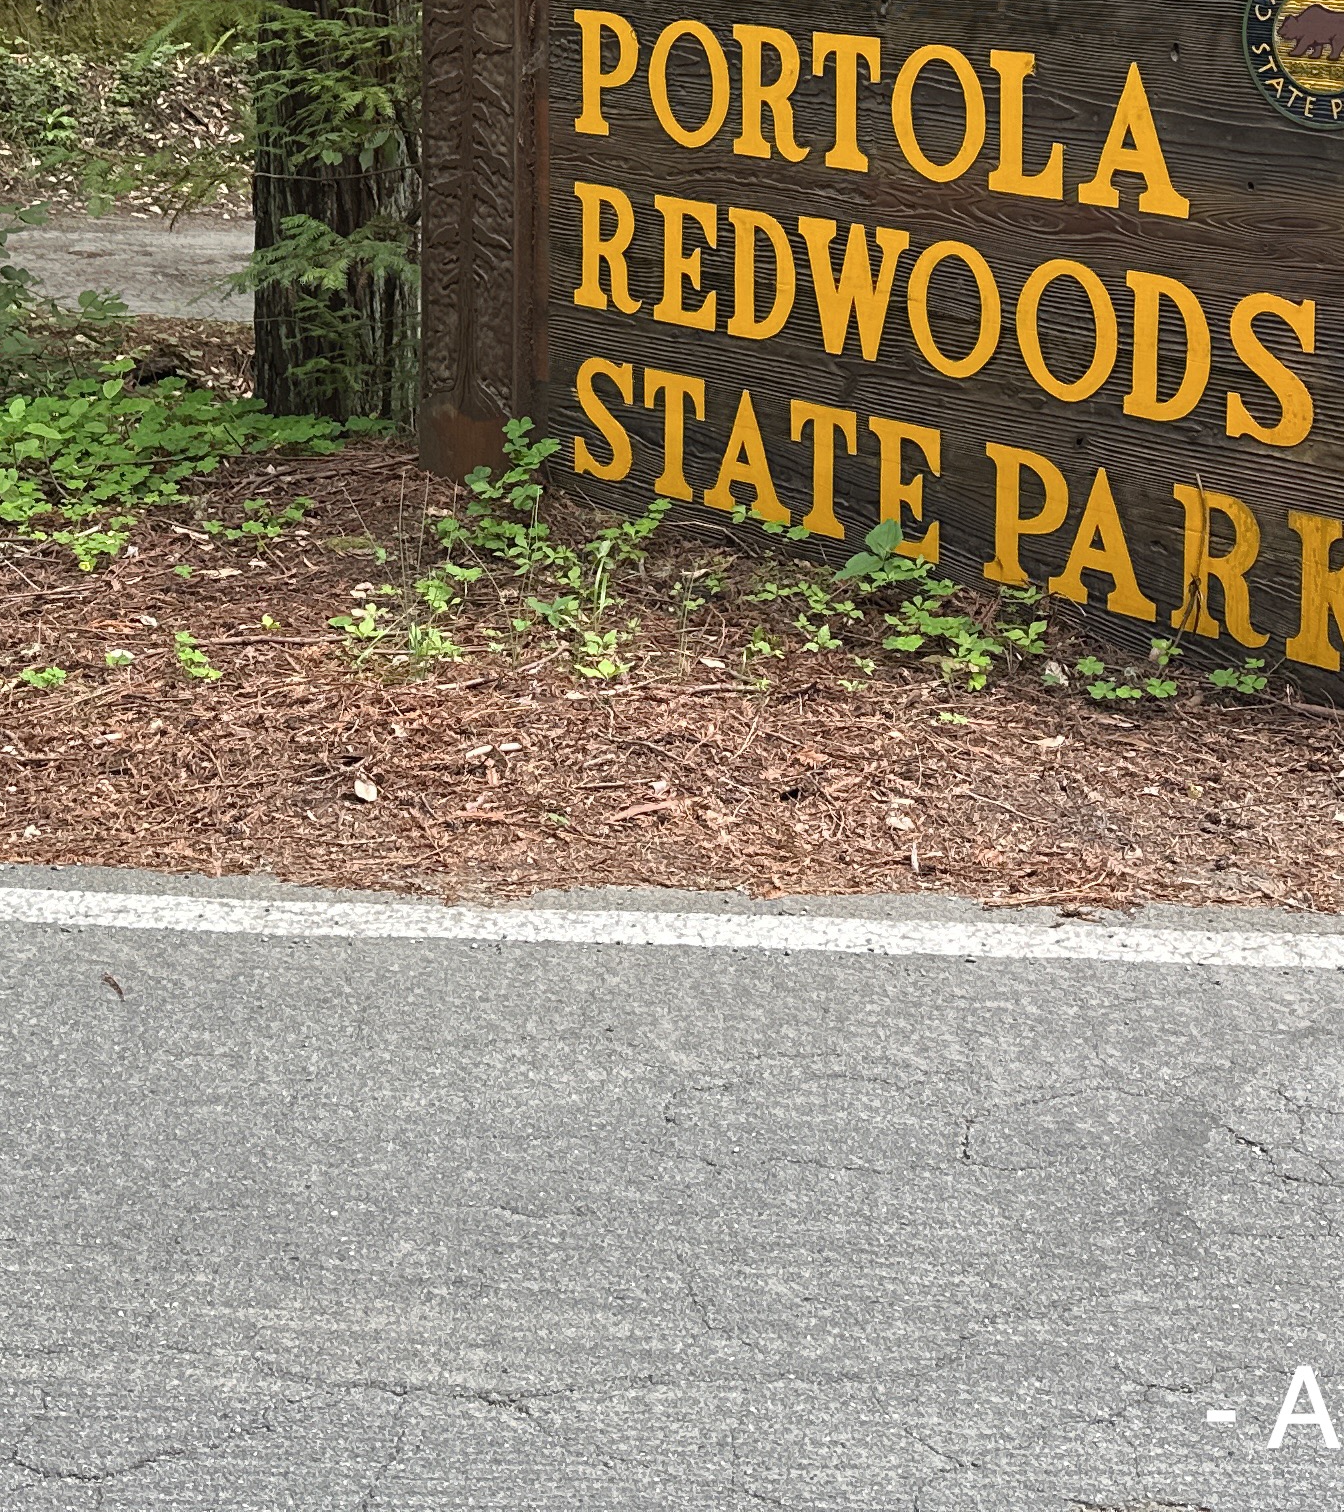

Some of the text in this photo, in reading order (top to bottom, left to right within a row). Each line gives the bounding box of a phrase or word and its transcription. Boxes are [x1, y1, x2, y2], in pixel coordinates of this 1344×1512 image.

[574, 9, 1190, 219] PORTOLA
[1251, 42, 1317, 118] STATE
[574, 181, 1316, 448] REDWOODS
[574, 357, 940, 565] STATE
